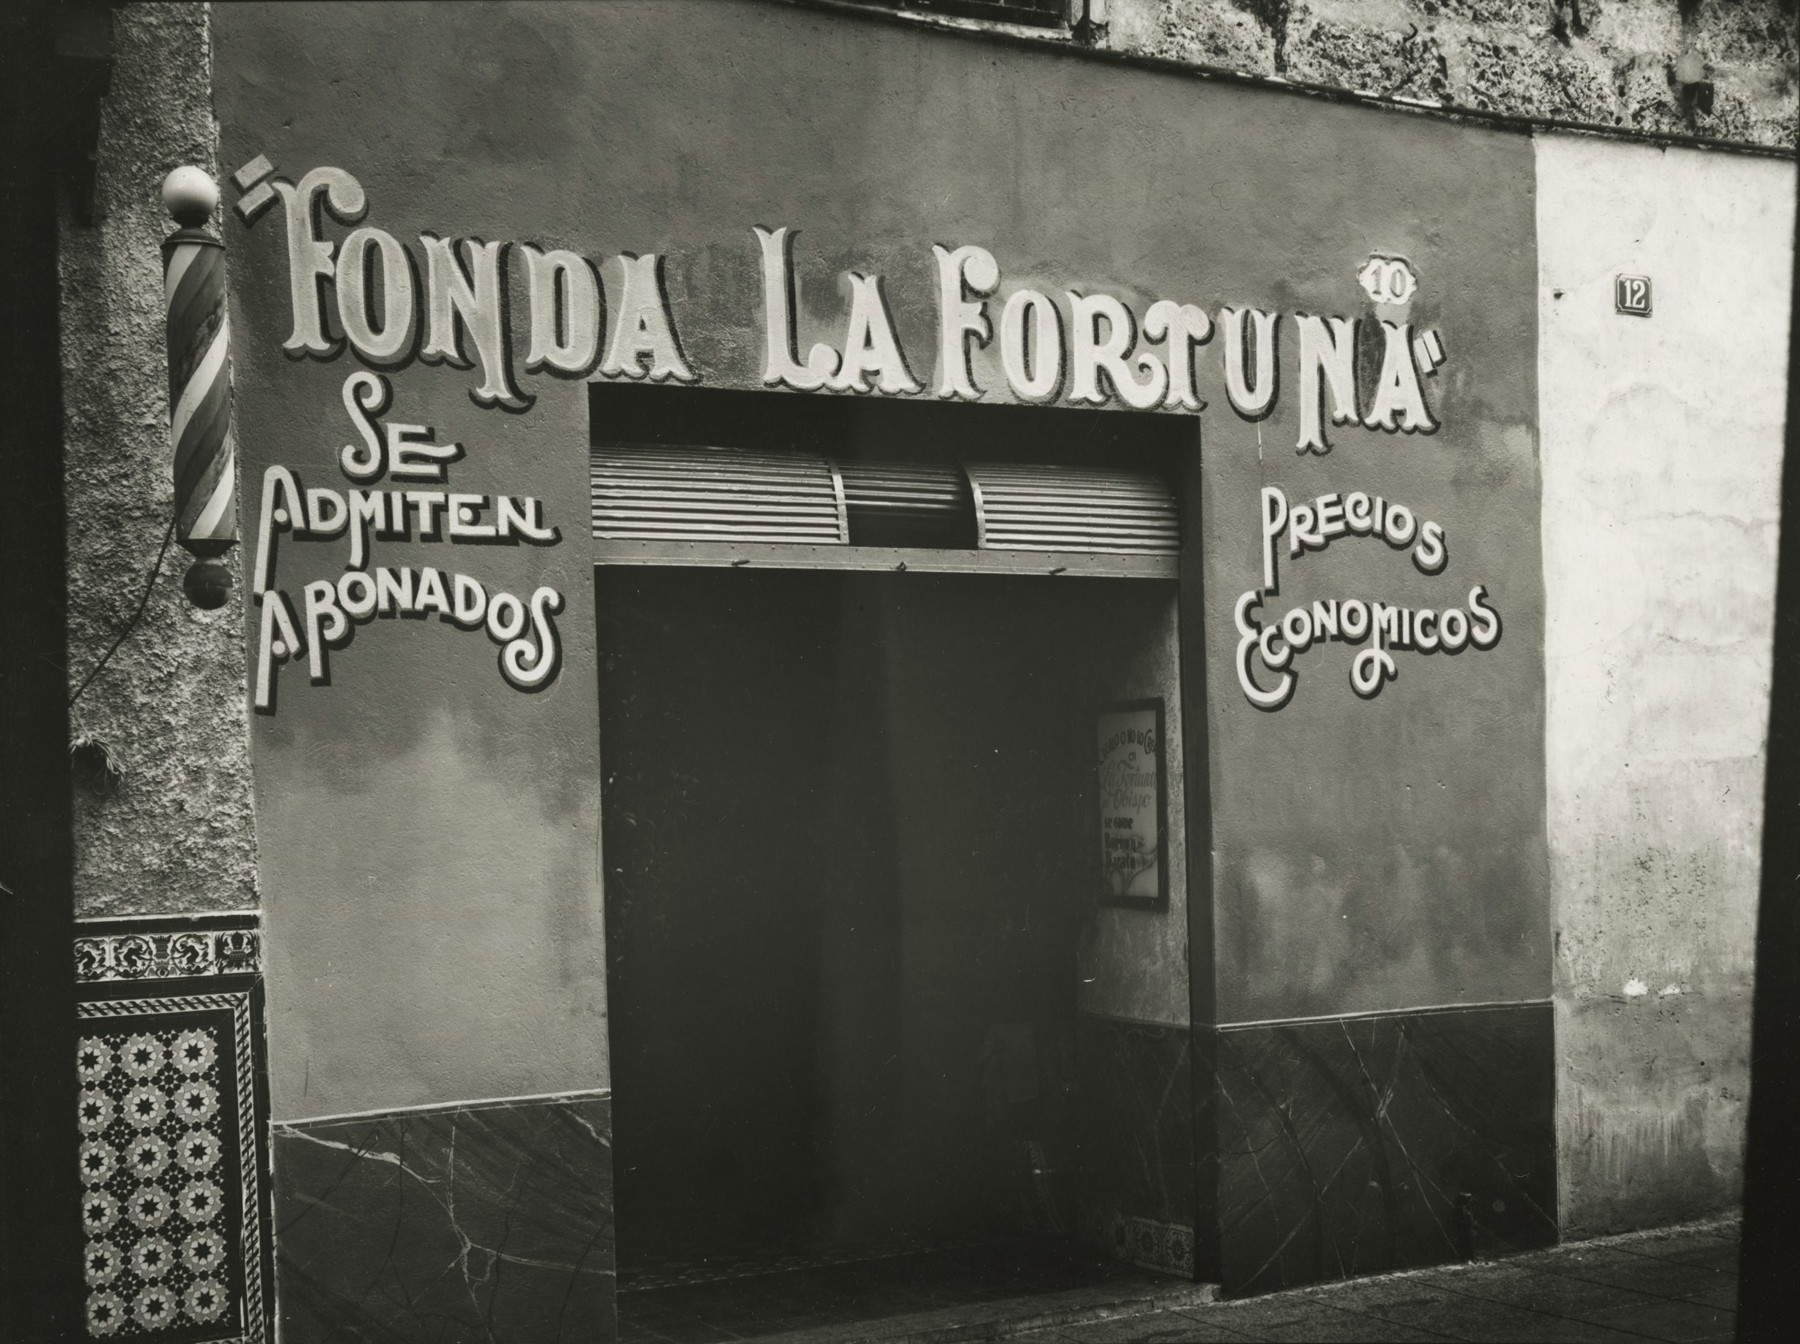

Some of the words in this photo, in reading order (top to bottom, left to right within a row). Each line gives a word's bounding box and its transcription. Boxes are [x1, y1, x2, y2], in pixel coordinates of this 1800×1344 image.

[753, 225, 927, 396] LA
[1370, 265, 1407, 299] 10
[1624, 279, 1646, 309] 12
[341, 370, 466, 485] SE
[253, 465, 562, 605] ADMITEN
[1261, 486, 1448, 595] PRECIOS
[254, 567, 565, 715] ABONADOS
[1234, 585, 1502, 712] ECONOMICOS
